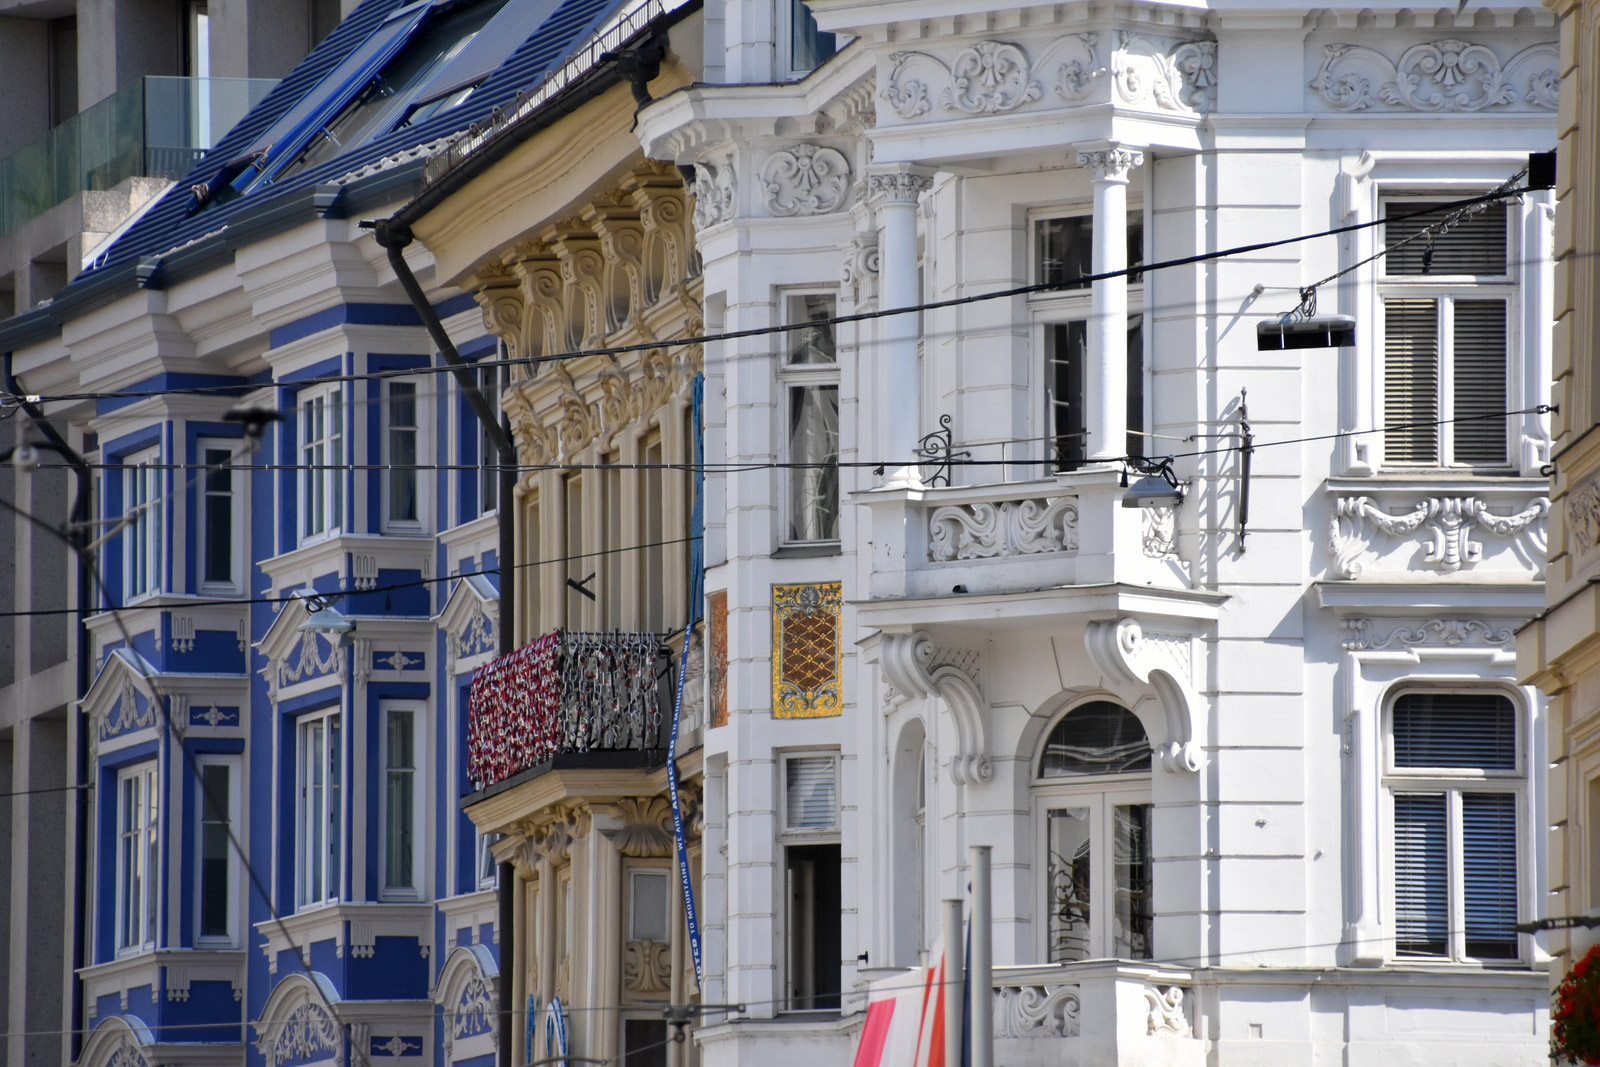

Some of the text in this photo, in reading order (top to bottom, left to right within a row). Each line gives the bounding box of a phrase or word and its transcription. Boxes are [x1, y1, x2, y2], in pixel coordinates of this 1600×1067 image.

[683, 640, 689, 654] WE
[674, 663, 686, 721] MOUNTAINS
[671, 723, 677, 736] TO
[667, 739, 678, 810] ADDICTED
[677, 835, 684, 852] WE
[680, 861, 694, 920] MOUNTAINS
[688, 922, 696, 935] TO
